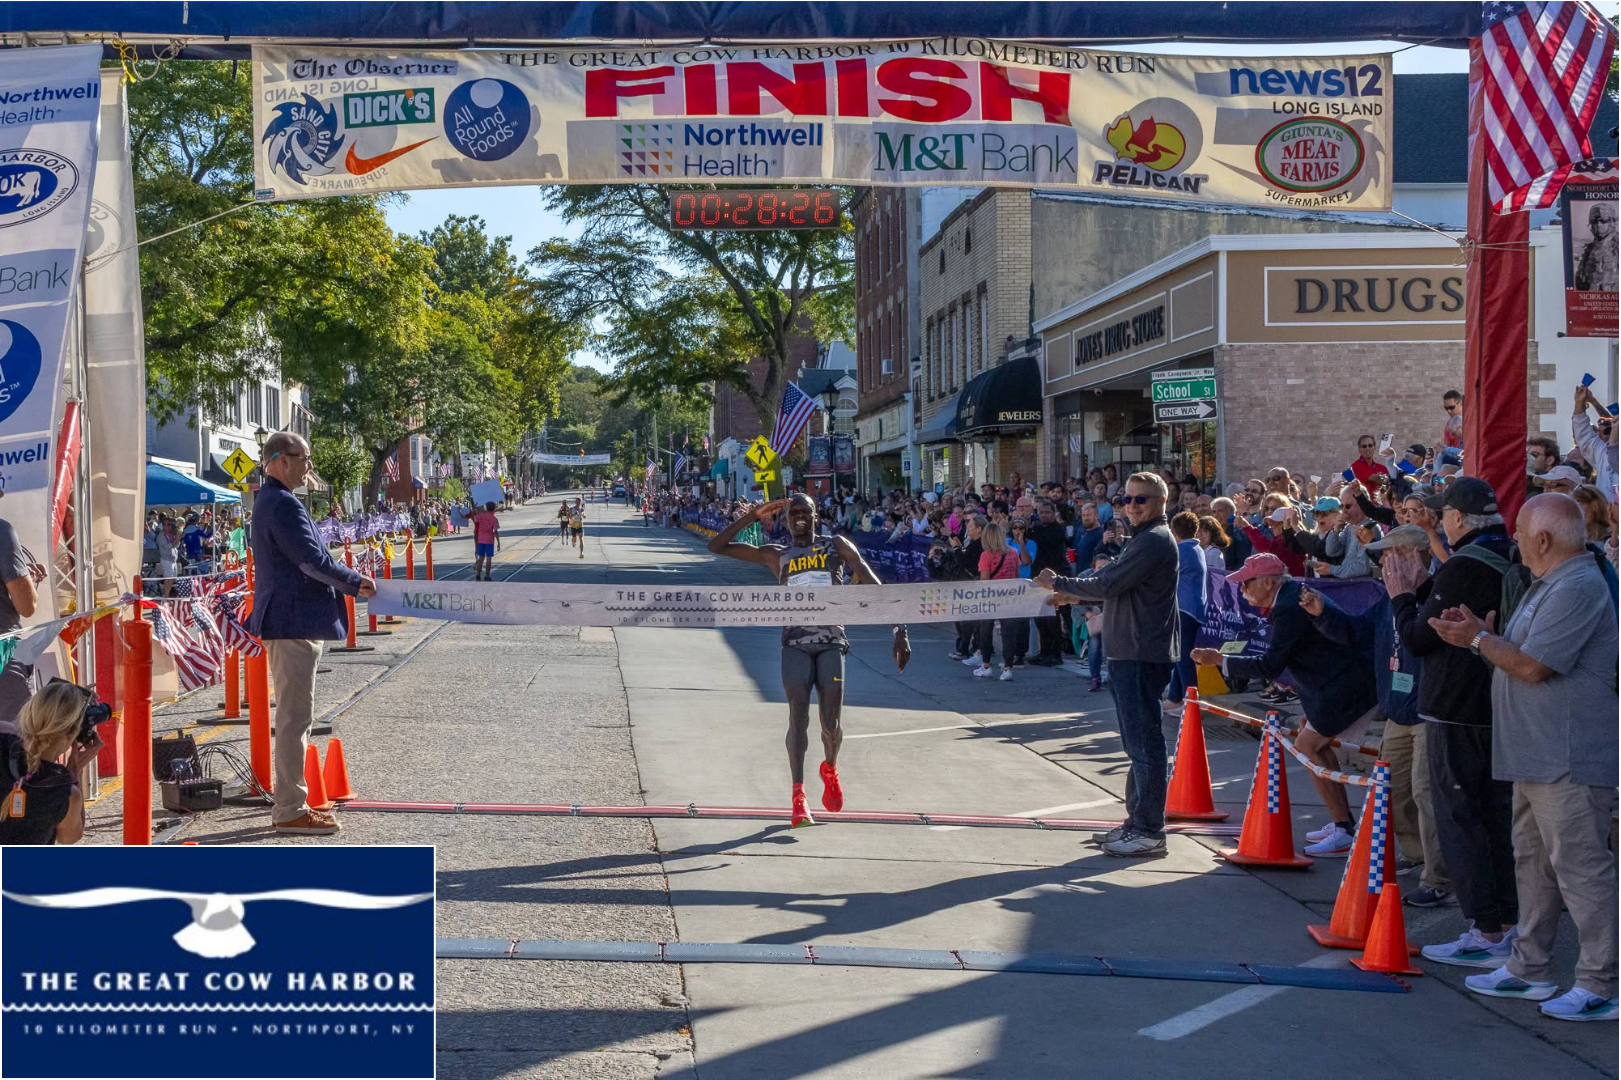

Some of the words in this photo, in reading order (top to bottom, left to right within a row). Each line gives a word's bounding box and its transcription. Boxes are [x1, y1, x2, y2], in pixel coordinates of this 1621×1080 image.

[500, 52, 558, 67] THE
[569, 51, 662, 67] GREAT
[672, 50, 738, 64] COW
[752, 44, 872, 60] HARBOR
[886, 42, 910, 53] 10
[920, 38, 1082, 69] KILOMETER
[1096, 55, 1156, 74] RUN
[292, 58, 338, 80] The
[345, 58, 456, 77] Observer
[1229, 64, 1383, 97] news12
[585, 57, 1072, 127] FINISH
[348, 90, 431, 125] DICK'S
[453, 104, 474, 128] All
[1272, 101, 1320, 115] LONG
[1326, 102, 1383, 116] ISLAND
[290, 106, 324, 128] SAND
[317, 130, 331, 162] CITY
[454, 106, 506, 146] Round
[684, 122, 823, 147] Northwell
[1280, 125, 1344, 143] GIUNTA'S
[874, 131, 975, 172] M&T
[981, 132, 1077, 174] Bank
[1281, 138, 1341, 160] MEAT
[1096, 163, 1200, 195] PELICAN
[1279, 161, 1340, 183] FARMS
[23, 204, 46, 218] LONG
[48, 187, 69, 207] ISLAND
[675, 192, 834, 226] 00:28:26
[1265, 188, 1350, 208] SUPERMARKET
[1294, 276, 1466, 314] DRUGS
[1075, 330, 1103, 366] JONES
[1104, 319, 1131, 356] DRUG
[1132, 305, 1164, 346] STORE
[1156, 382, 1191, 399] School
[1203, 386, 1211, 396] St
[997, 410, 1042, 421] JEWELERS
[1161, 408, 1179, 417] ONE
[1180, 406, 1198, 415] WAY
[788, 553, 828, 574] ARMY
[401, 591, 448, 611] M&T
[449, 592, 494, 612] Bank
[617, 590, 646, 602] THE
[656, 590, 701, 603] GREAT
[708, 592, 747, 603] COW
[752, 591, 816, 602] HARBOR
[952, 584, 1027, 601] Northwell
